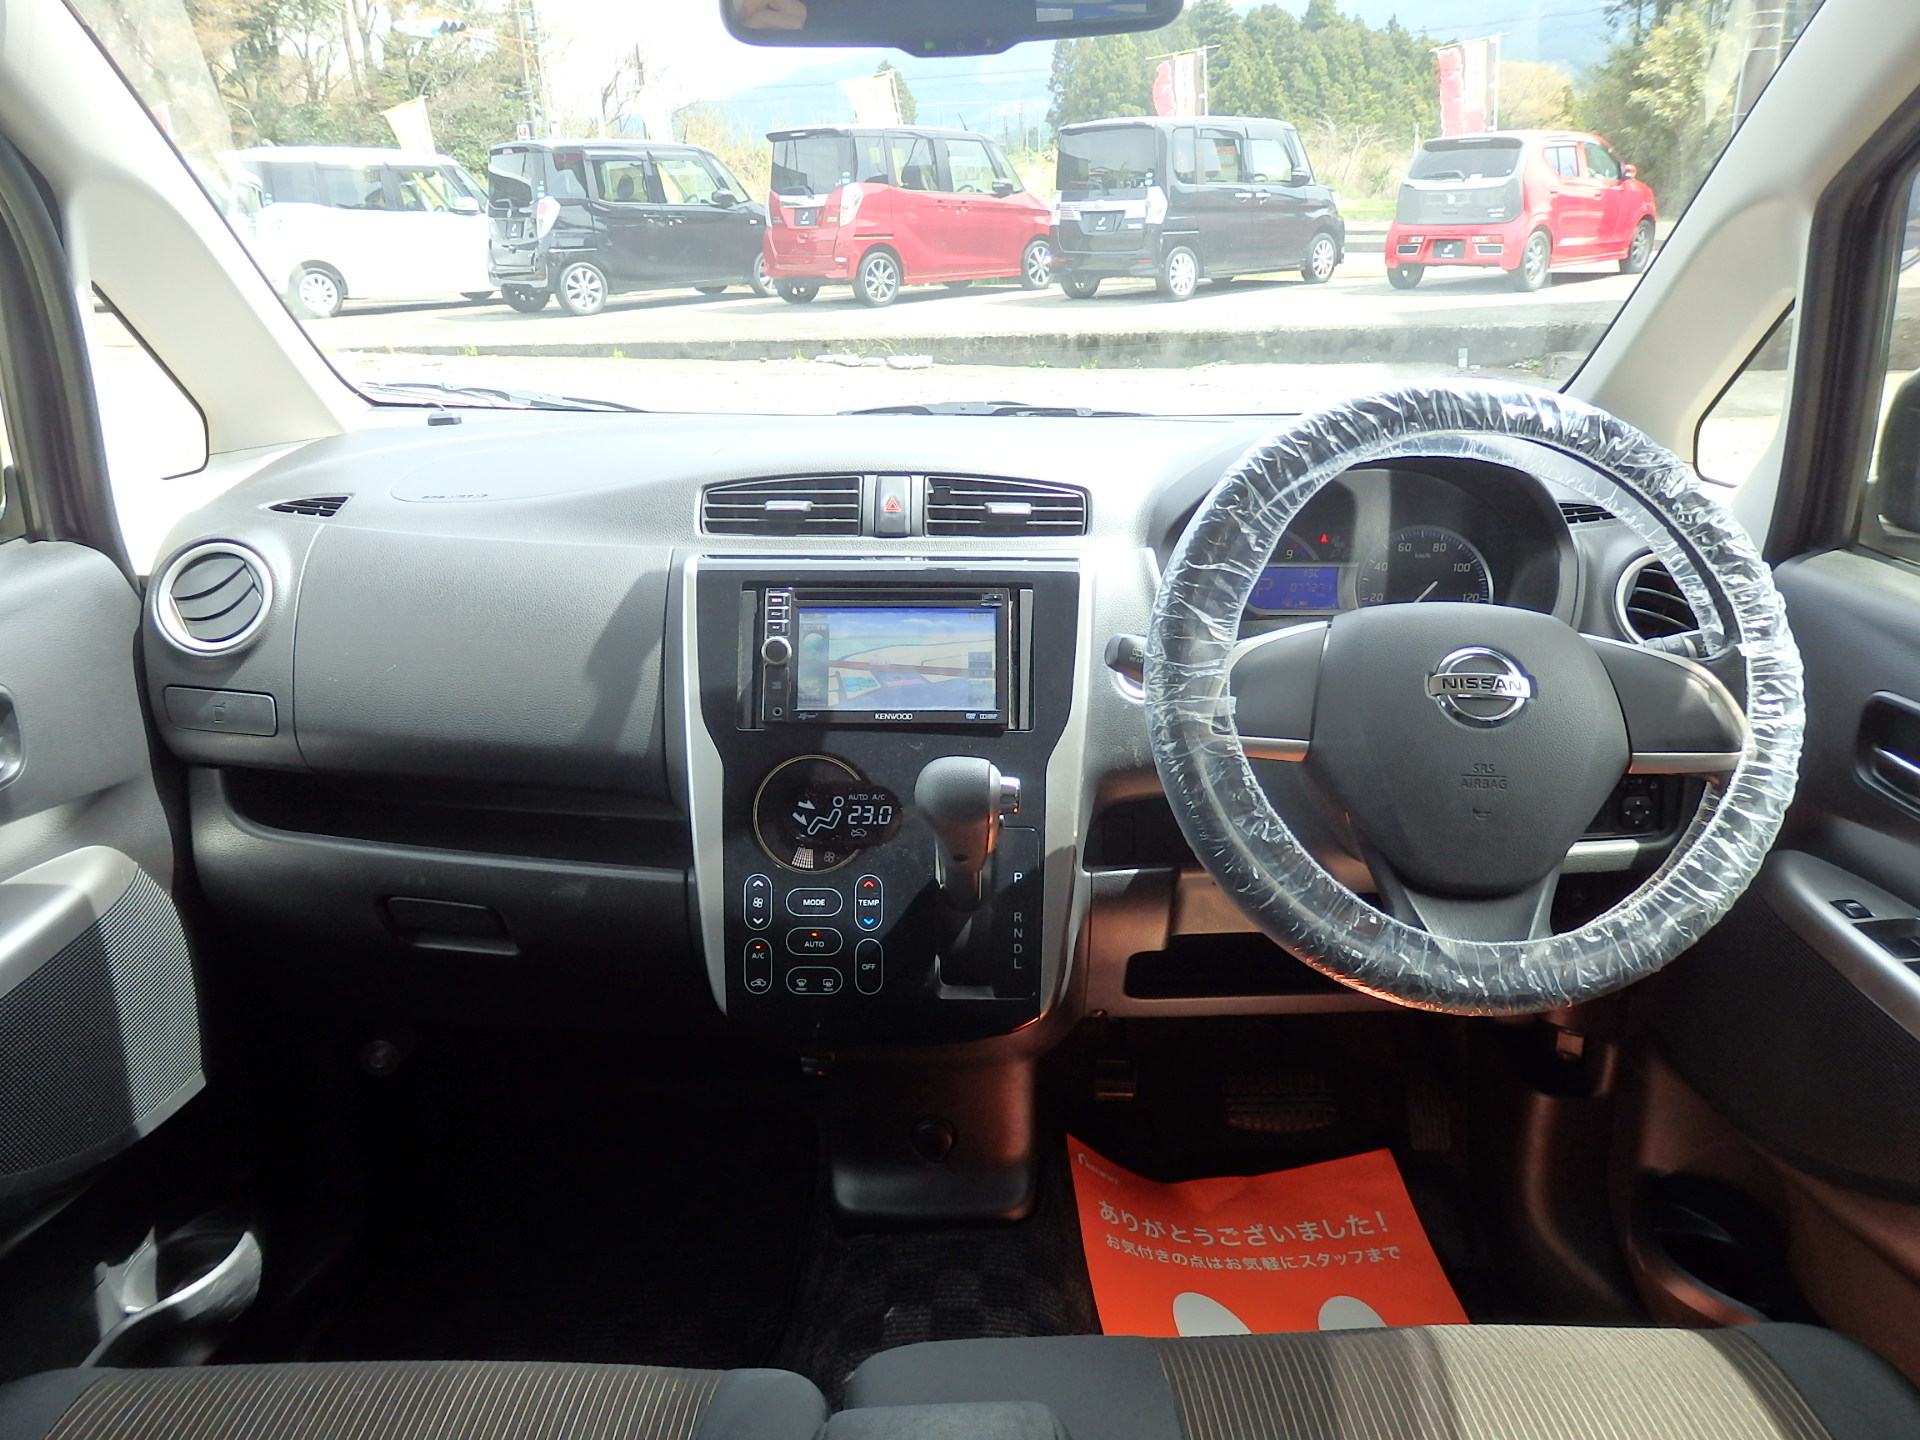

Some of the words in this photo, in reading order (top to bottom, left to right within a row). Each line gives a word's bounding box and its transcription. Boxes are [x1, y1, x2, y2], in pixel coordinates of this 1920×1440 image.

[1397, 542, 1412, 552] 60
[1432, 542, 1447, 552] 80
[1285, 549, 1294, 559] 9
[1374, 561, 1389, 571] 40
[1452, 562, 1471, 572] 100
[1369, 592, 1384, 602] 20
[1462, 592, 1480, 602] 120
[1442, 677, 1522, 692] NISSAN
[1472, 763, 1495, 774] SRS
[1460, 778, 1508, 790] AIRBAG
[847, 805, 892, 825] 23.0
[1013, 872, 1023, 883] P
[1013, 912, 1023, 922] R
[1013, 928, 1023, 938] N
[1013, 944, 1023, 954] D
[751, 952, 765, 960] A/C
[1013, 959, 1022, 969] L
[1098, 1200, 1389, 1247] ありがとうございました!
[1104, 1233, 1401, 1272] お気付きの点はお気軽にスタッフまで
